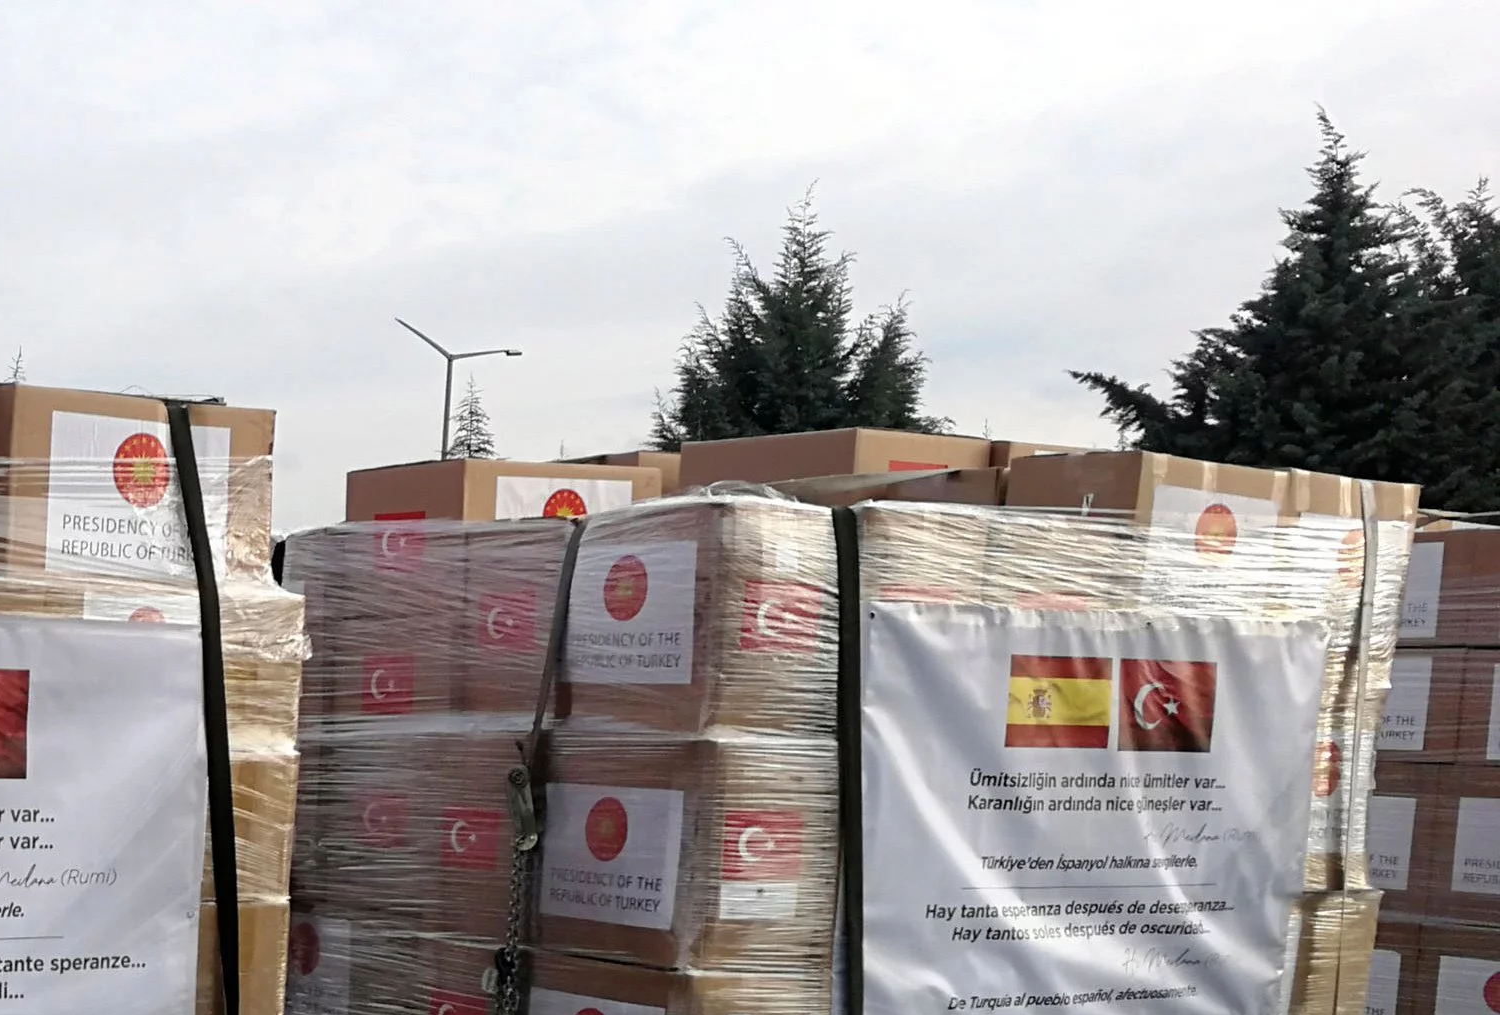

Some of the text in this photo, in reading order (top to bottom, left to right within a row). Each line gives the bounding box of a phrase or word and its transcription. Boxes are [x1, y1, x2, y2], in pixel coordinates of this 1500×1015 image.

[62, 514, 158, 536] PRESIDENCY
[61, 539, 132, 560] REPUBLIC
[136, 545, 156, 560] OF
[640, 633, 654, 646] OF
[658, 632, 681, 646] THE
[636, 654, 681, 668] TURKEY
[1396, 715, 1415, 726] THE
[1380, 730, 1415, 740] URKEY
[969, 768, 1056, 790] Ümitsizliğin
[1061, 772, 1116, 788] ardında
[1120, 773, 1141, 789] nice
[1143, 772, 1190, 789] ümitler
[968, 795, 1044, 814] Karanlığın
[1048, 796, 1101, 812] ardında
[1106, 797, 1134, 812] nice
[1136, 795, 1185, 815] güneşler
[11, 808, 55, 823] var...
[10, 835, 54, 850] var...
[1056, 854, 1108, 871] İspanyol
[1109, 855, 1150, 869] halkına
[1379, 854, 1398, 866] THE
[61, 867, 118, 887] (Rumi)
[617, 874, 633, 889] OF
[637, 876, 663, 892] THE
[600, 892, 613, 907] OF
[615, 895, 661, 912] TURKEY
[925, 904, 957, 920] Hay
[960, 903, 998, 919] tanta
[1002, 904, 1061, 921] esperanza
[1065, 900, 1123, 918] después
[1127, 899, 1146, 915] de
[952, 926, 982, 942] Hay
[986, 925, 1030, 941] tantos
[1033, 924, 1061, 939] soles
[1064, 922, 1115, 939] después
[1119, 920, 1137, 935] de
[50, 954, 147, 975] speranze...
[948, 997, 966, 1010] De
[970, 995, 1012, 1010] Turquía
[1014, 993, 1024, 1007] al
[1027, 993, 1069, 1009] pueblo
